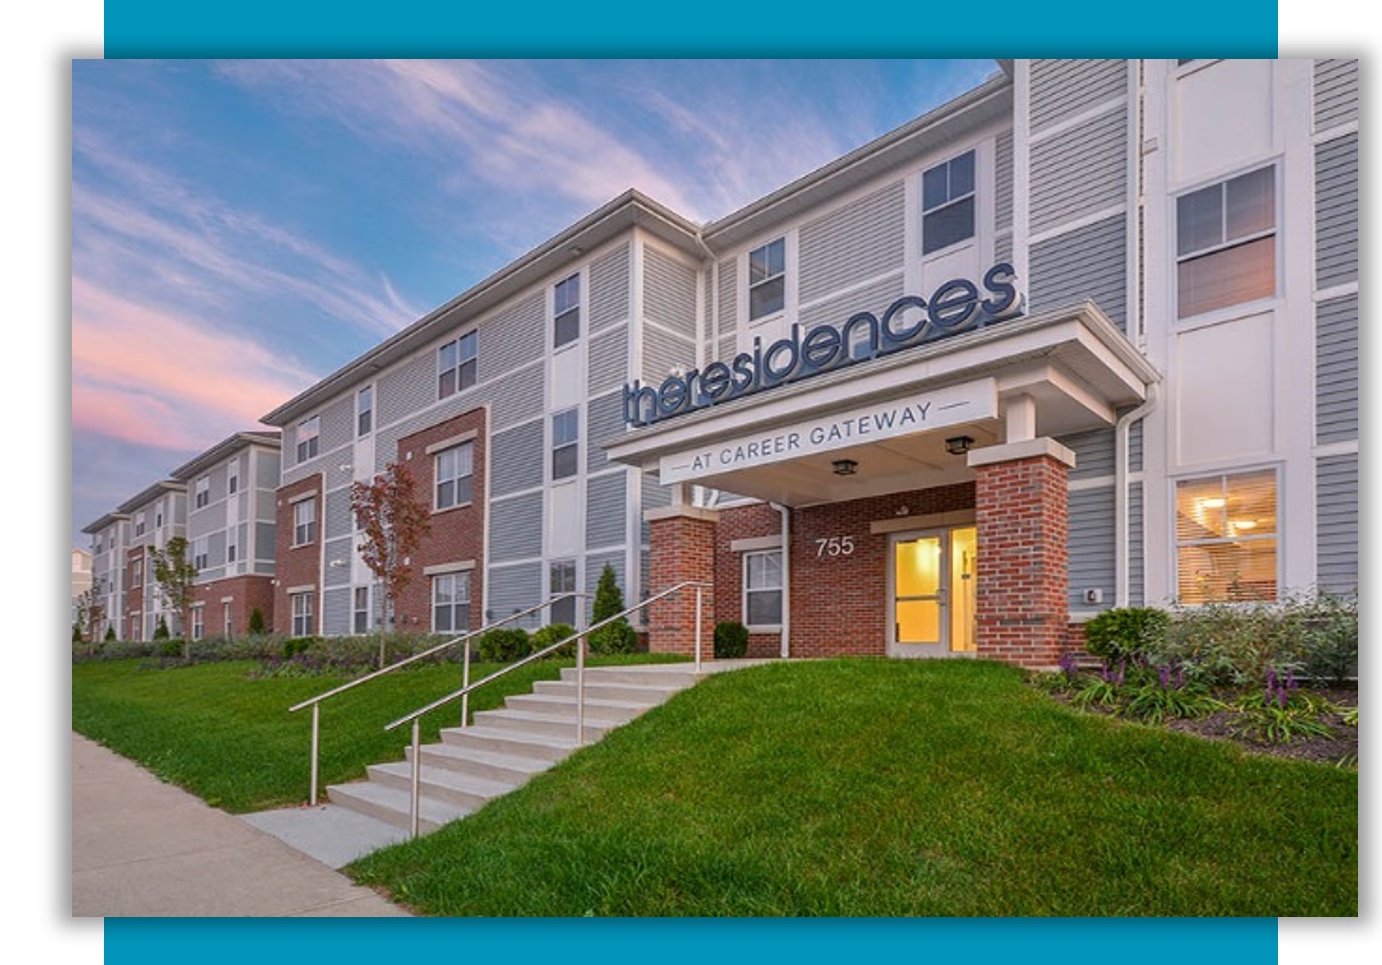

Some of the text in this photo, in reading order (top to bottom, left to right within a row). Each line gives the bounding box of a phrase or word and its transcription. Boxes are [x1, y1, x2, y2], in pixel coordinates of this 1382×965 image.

[691, 402, 932, 472] AT CAREER GATEWAY
[815, 536, 854, 557] 755
